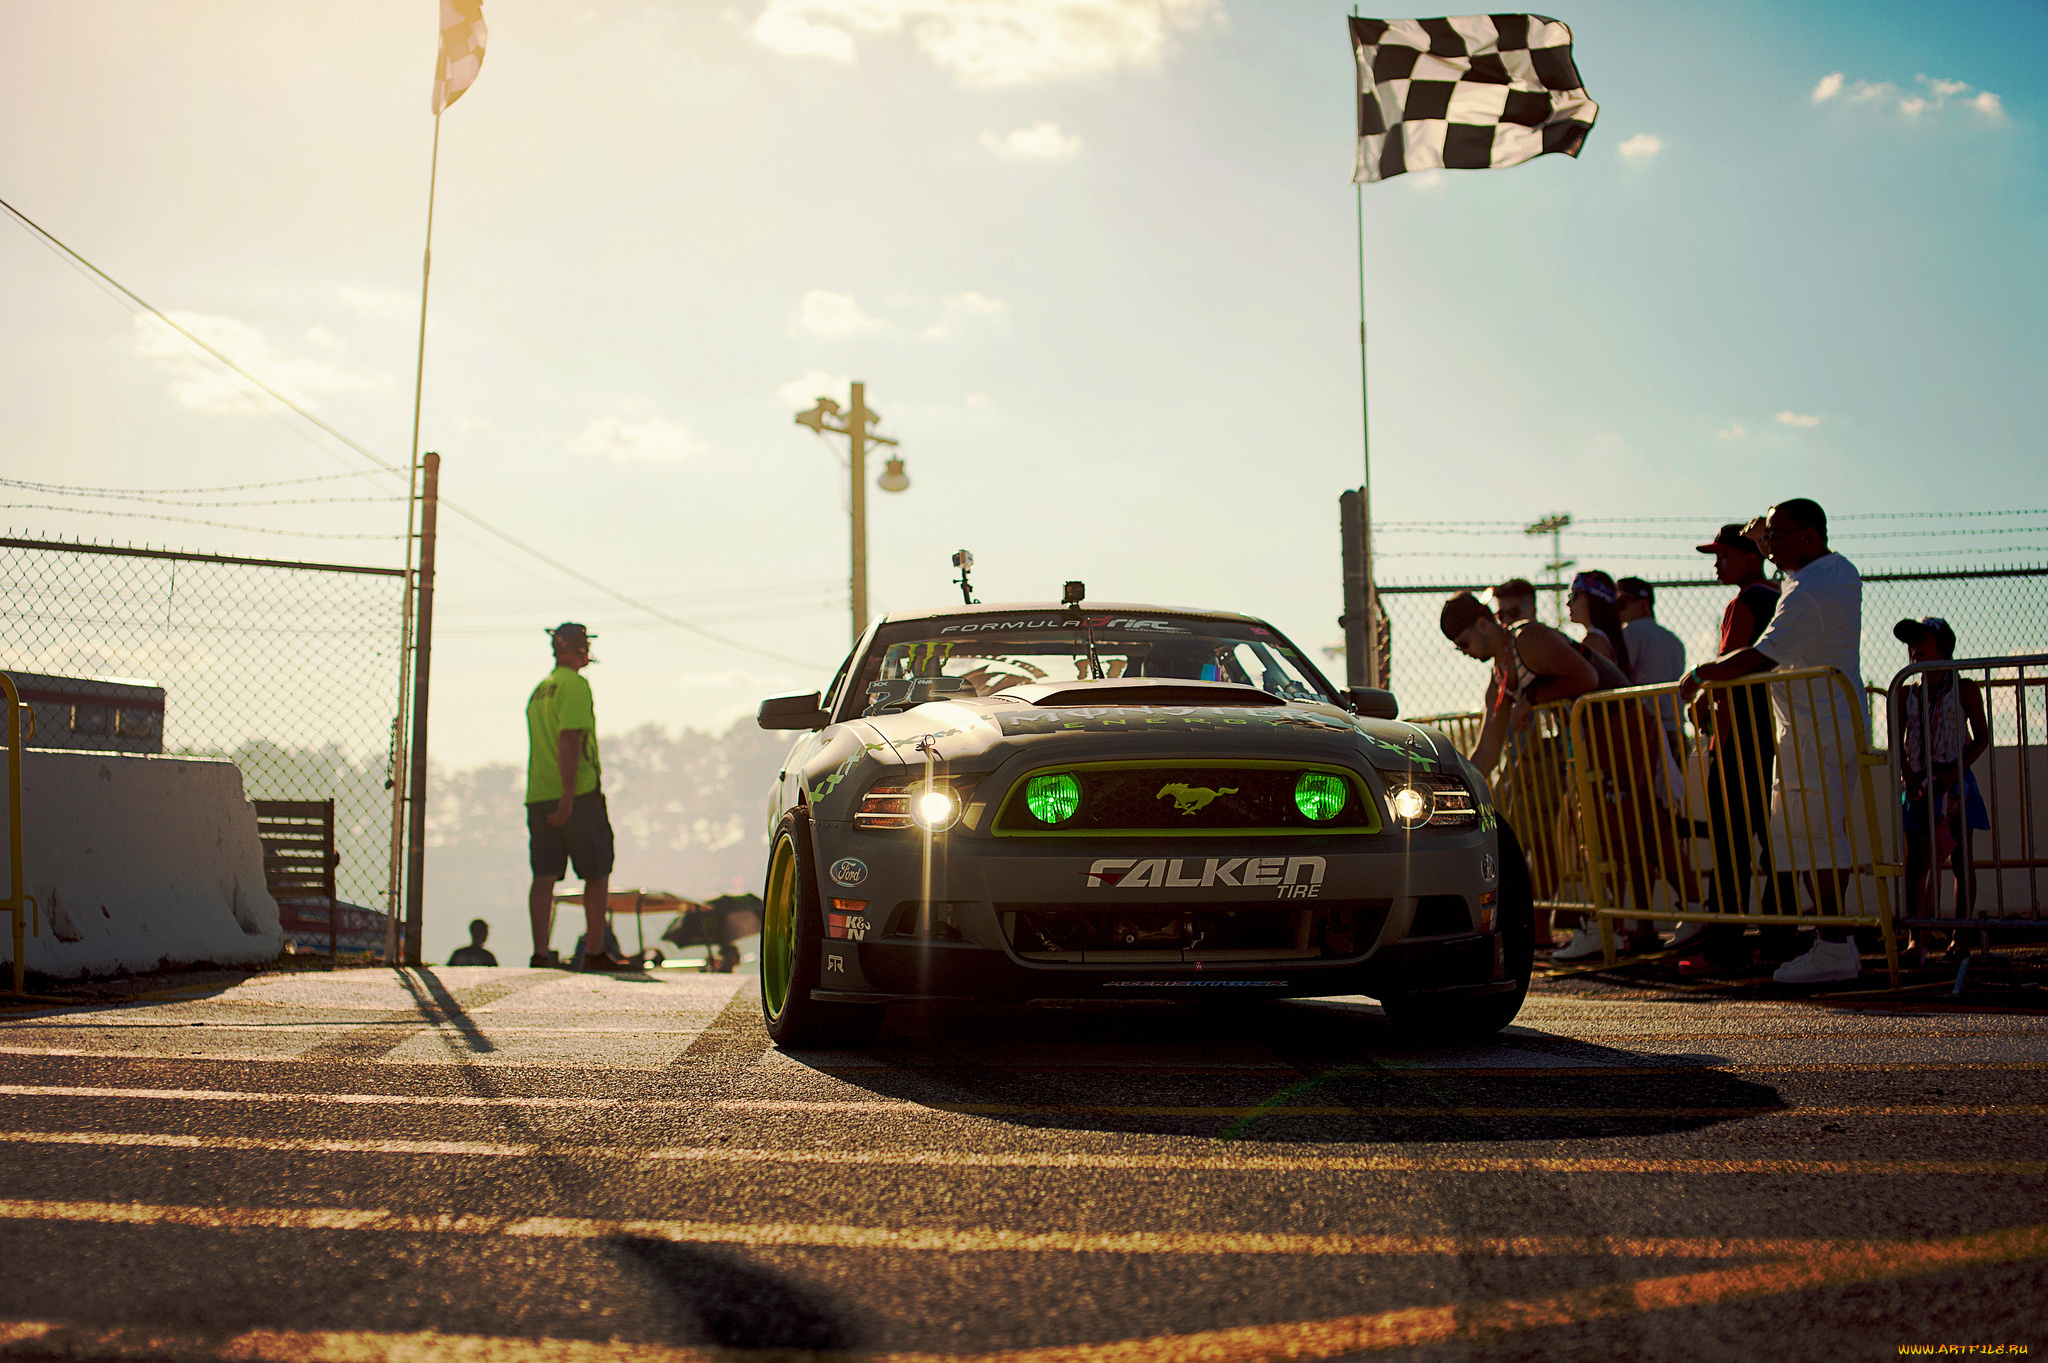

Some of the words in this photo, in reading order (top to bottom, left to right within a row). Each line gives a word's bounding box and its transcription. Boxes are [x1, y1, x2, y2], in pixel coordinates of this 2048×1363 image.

[940, 619, 1081, 634] FORMULA
[1063, 717, 1283, 729] ENERGY
[837, 860, 862, 882] Ford
[1086, 856, 1327, 888] FALKEN
[1277, 884, 1322, 899] TIRE
